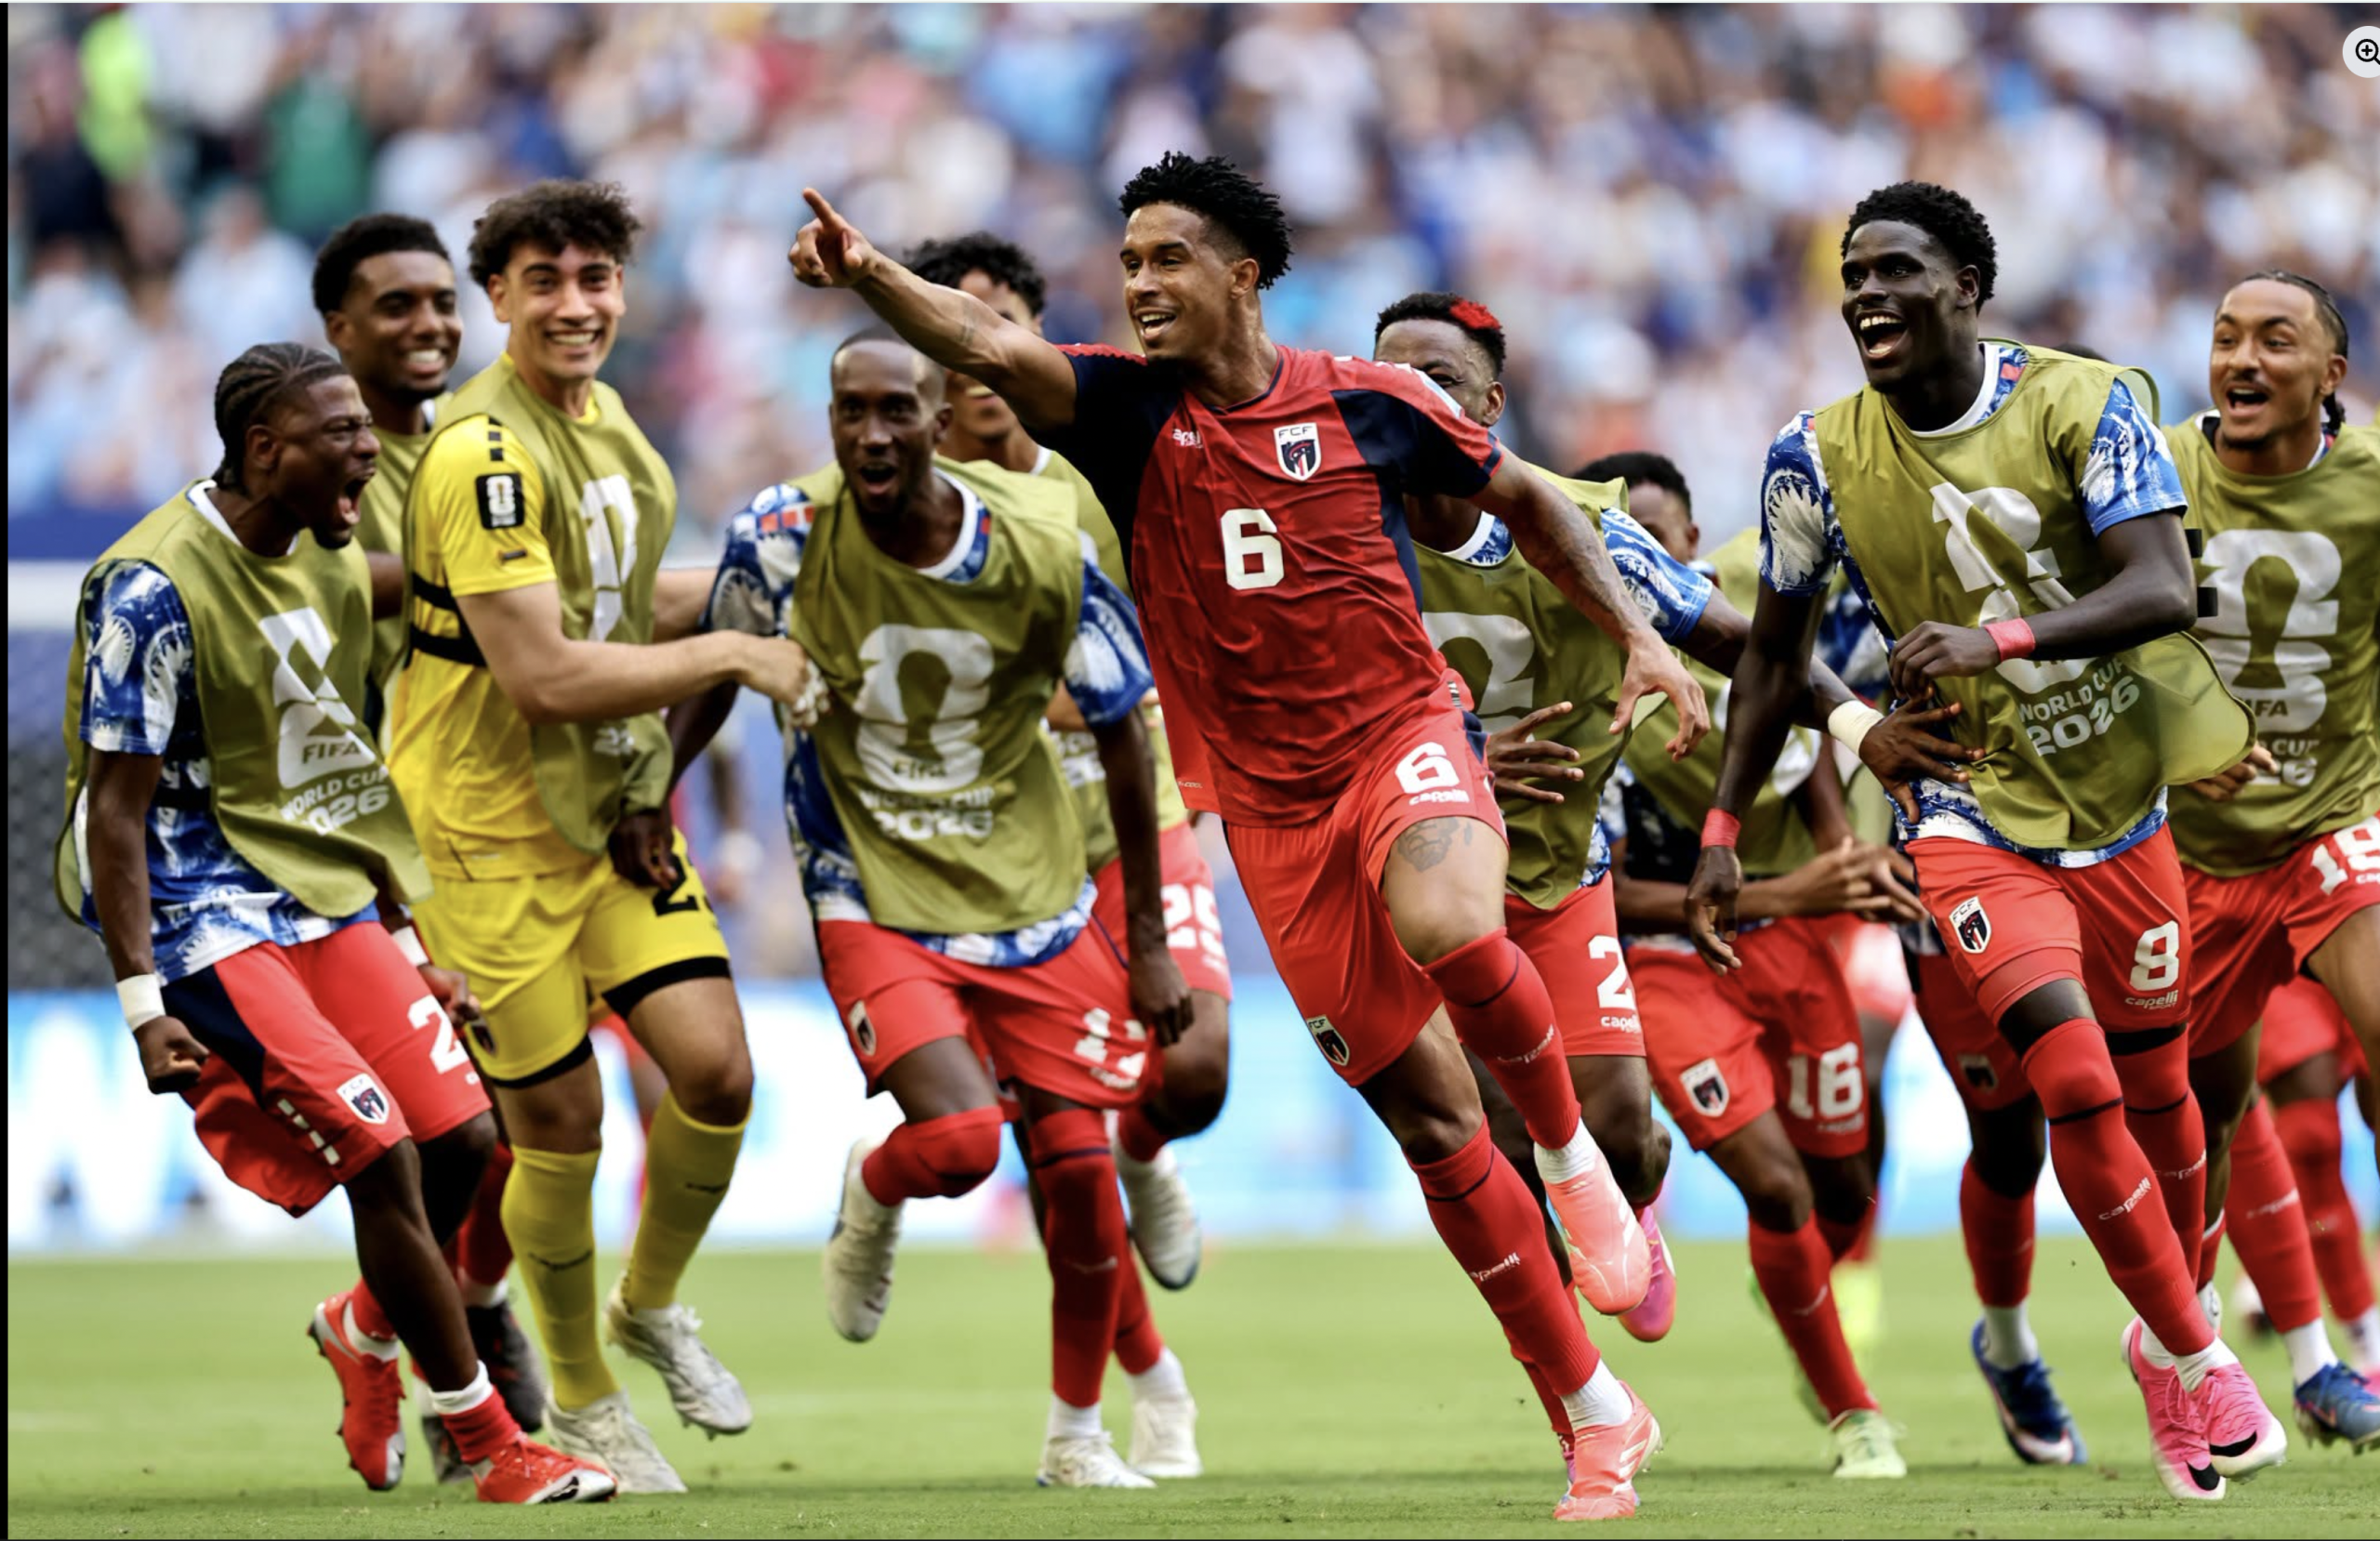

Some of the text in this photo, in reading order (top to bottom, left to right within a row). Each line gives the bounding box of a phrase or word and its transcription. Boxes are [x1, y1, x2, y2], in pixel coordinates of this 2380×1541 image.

[1278, 426, 1314, 439] FCF
[1221, 508, 1285, 591] 6
[2026, 676, 2140, 757] 2026
[302, 741, 362, 764] FIFA
[1395, 741, 1461, 795] 6
[301, 784, 389, 836] 026
[2129, 919, 2180, 992] 8
[2124, 989, 2179, 1009] capelli
[1787, 1042, 1864, 1121] 16
